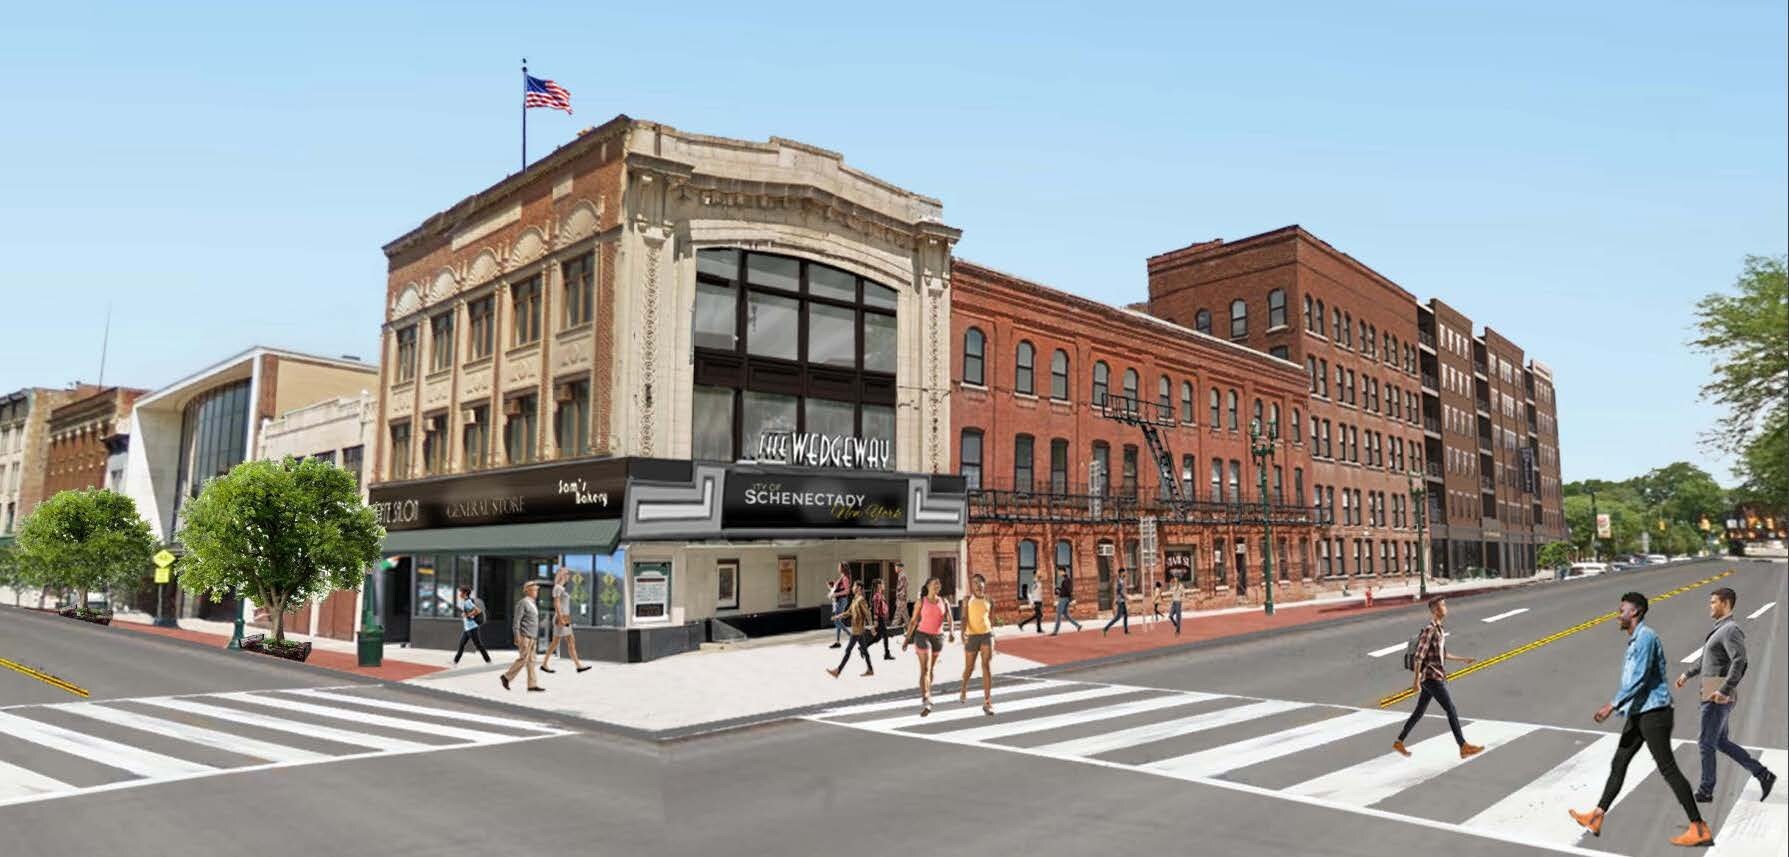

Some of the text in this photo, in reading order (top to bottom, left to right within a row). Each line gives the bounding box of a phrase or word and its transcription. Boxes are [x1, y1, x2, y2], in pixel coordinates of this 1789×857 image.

[792, 432, 889, 468] WEDGEWAY
[558, 477, 587, 494] Sam's
[744, 489, 865, 507] SCHENECTADY
